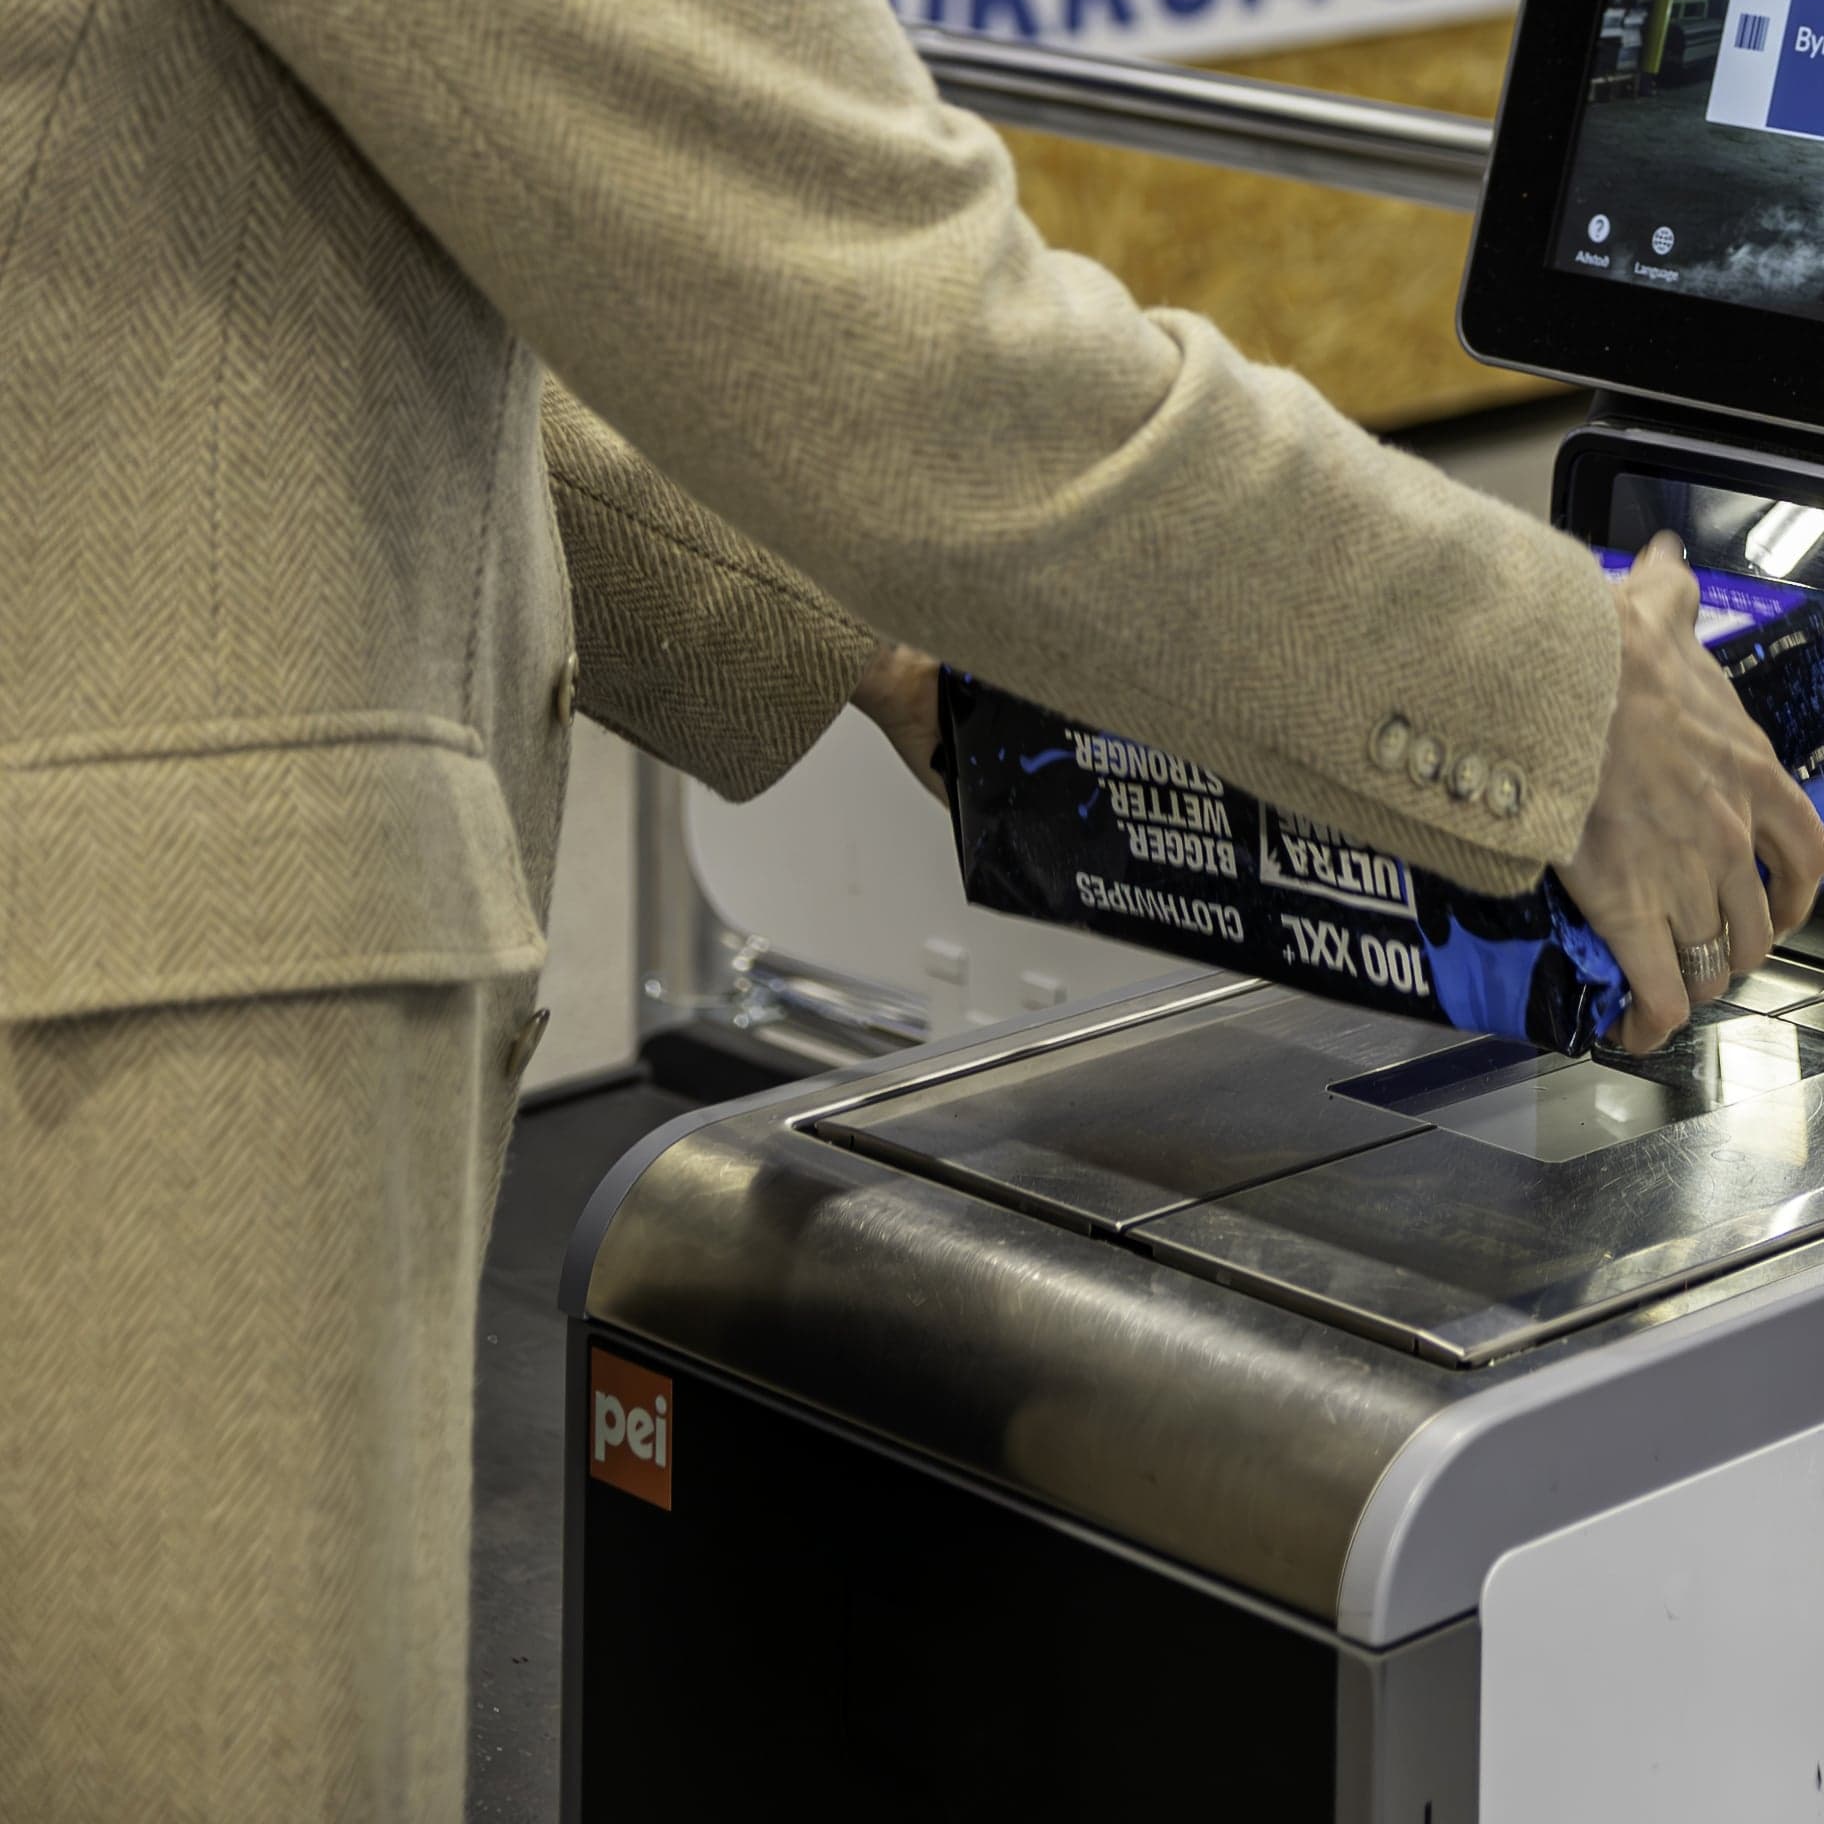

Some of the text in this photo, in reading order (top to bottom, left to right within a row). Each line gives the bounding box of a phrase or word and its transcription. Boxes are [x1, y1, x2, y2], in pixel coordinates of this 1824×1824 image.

[1098, 777, 1233, 839] WETTER.
[1117, 819, 1238, 879] BIGGER.
[1281, 833, 1402, 900] ULTRA
[1075, 871, 1245, 944] CLOTHWIPES
[1358, 934, 1430, 997] 100
[594, 1389, 668, 1469] pei
